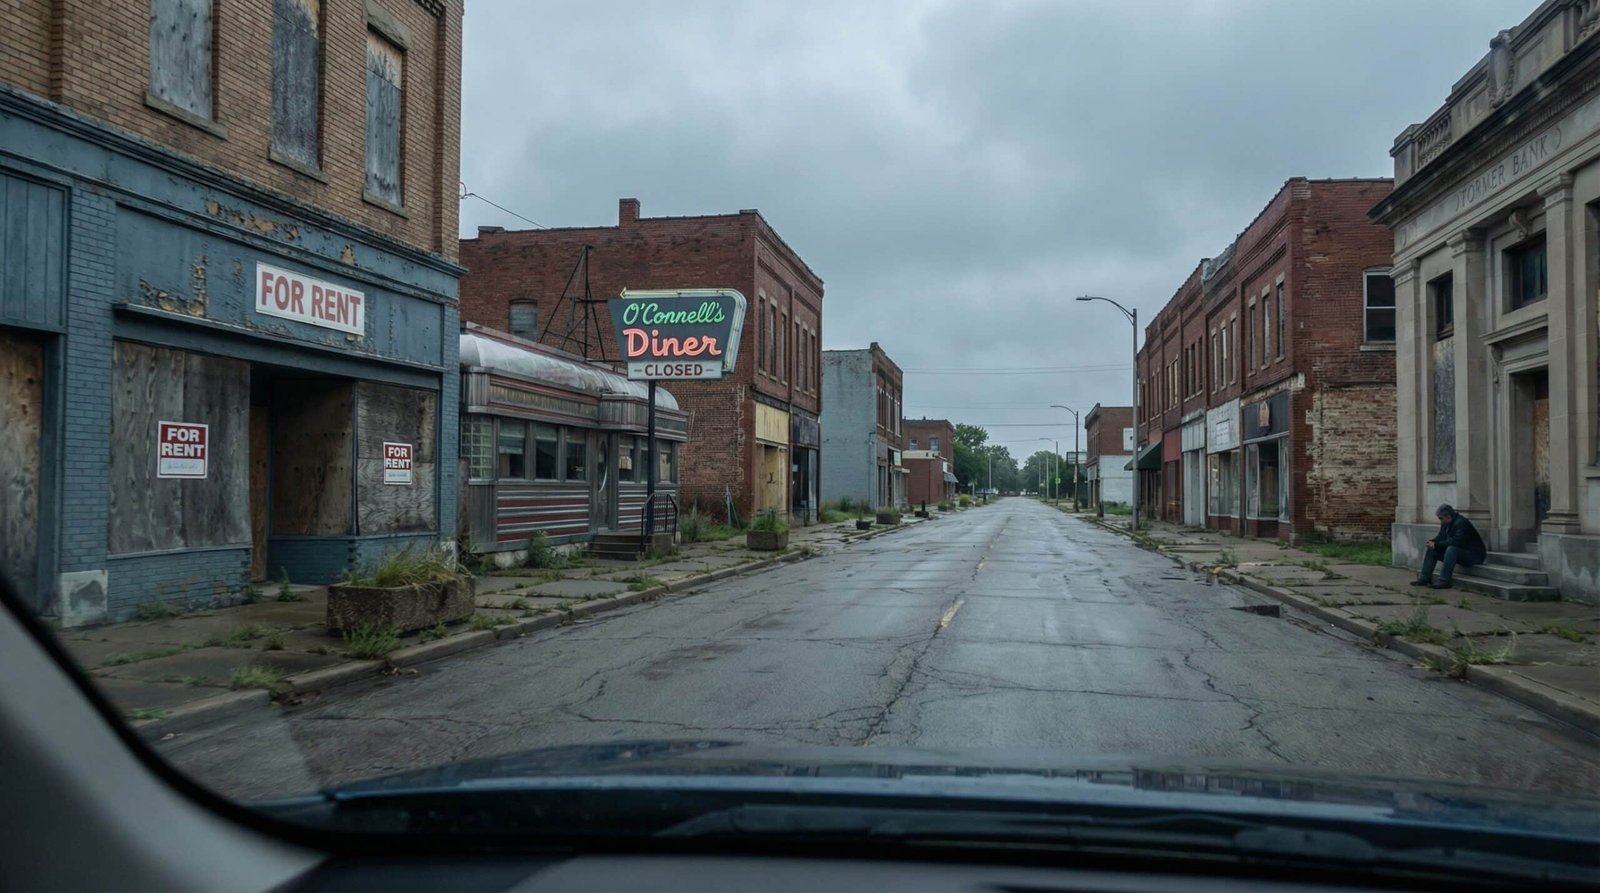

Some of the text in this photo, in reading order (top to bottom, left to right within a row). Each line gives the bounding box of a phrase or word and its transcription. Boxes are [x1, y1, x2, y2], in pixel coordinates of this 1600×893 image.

[1513, 135, 1548, 175] BANK
[261, 271, 360, 327] FOR RENT
[623, 301, 725, 325] O'Connell's
[622, 328, 722, 357] Diner
[644, 364, 703, 377] CLOSED
[167, 427, 200, 442] FOR
[161, 442, 204, 457] RENT
[388, 446, 408, 458] FOR
[385, 457, 411, 469] RENT
